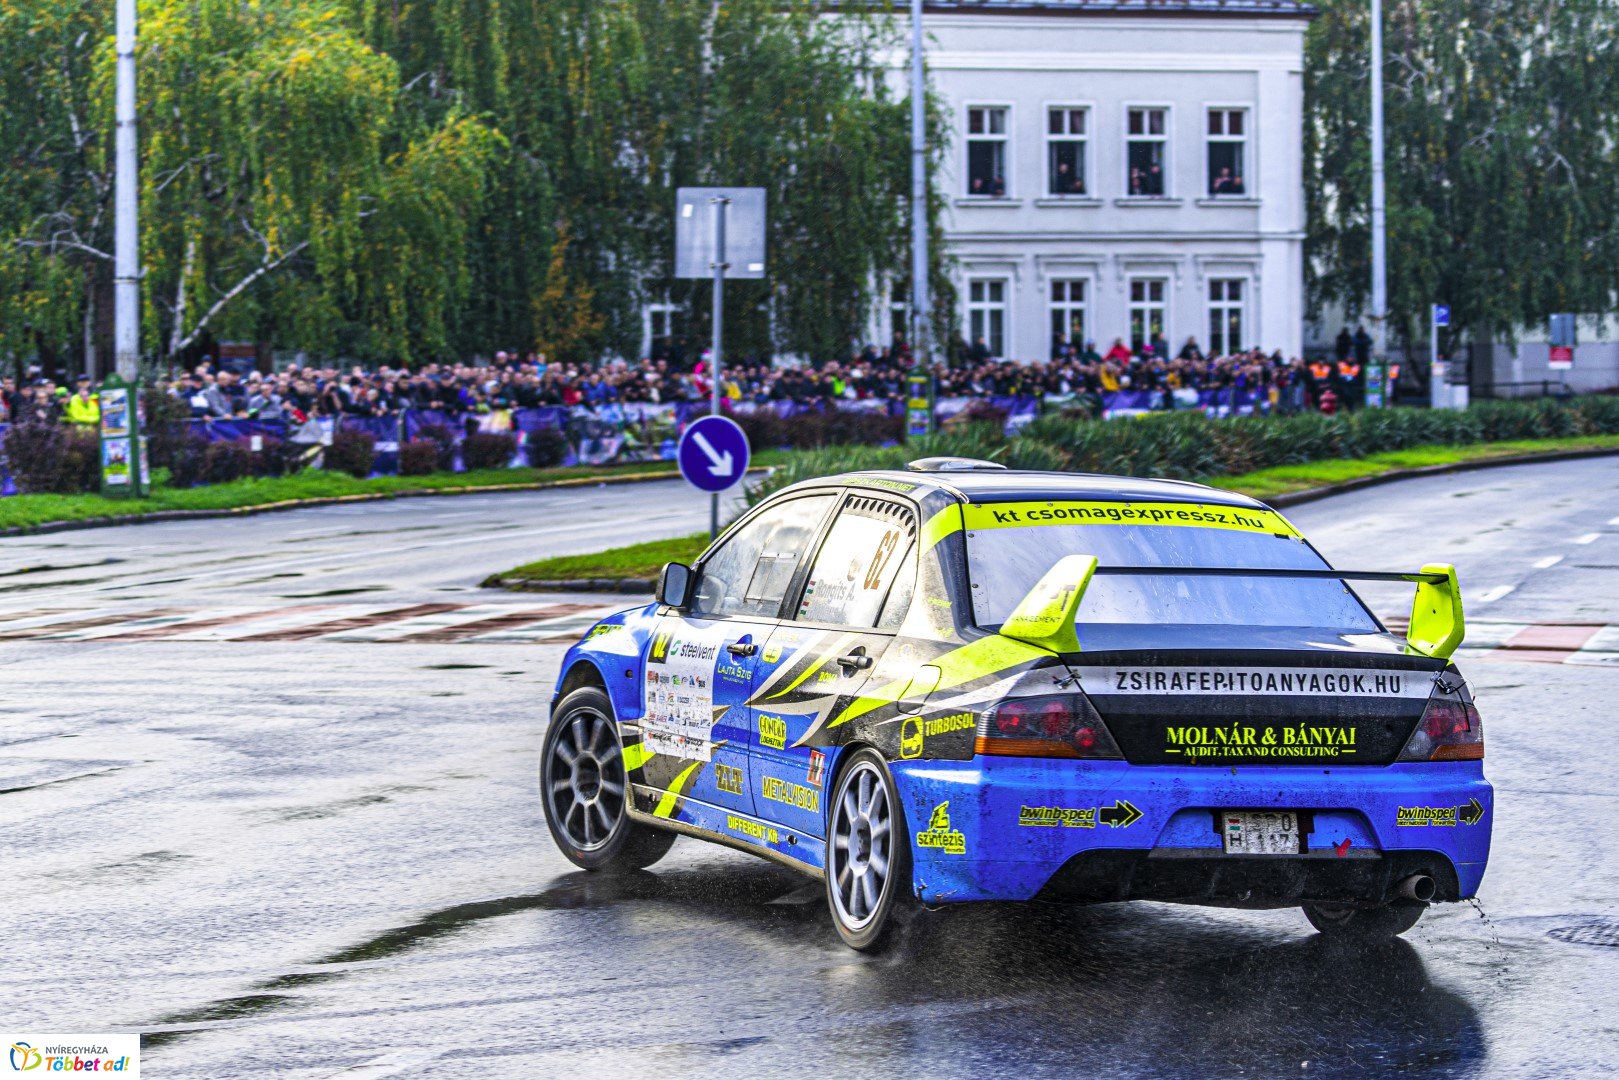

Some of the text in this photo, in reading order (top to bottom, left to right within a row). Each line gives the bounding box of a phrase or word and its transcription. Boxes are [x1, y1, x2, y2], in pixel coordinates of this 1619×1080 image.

[994, 505, 1265, 530] kt csomagexpressz.hu
[863, 530, 900, 590] 62
[1012, 614, 1062, 624] ANAGEMENT
[680, 640, 717, 661] steelvent
[1116, 671, 1401, 694] ZSIRAFEPITOANYAGOK.HU
[924, 712, 977, 737] TURBOSOL
[1167, 722, 1357, 745] MOLNÁR & BÁNYAI
[1243, 746, 1268, 756] AND
[1270, 746, 1339, 757] CONSULTING
[763, 776, 819, 813] METALVISION
[727, 816, 766, 840] DIFFERENT
[1230, 833, 1242, 846] H
